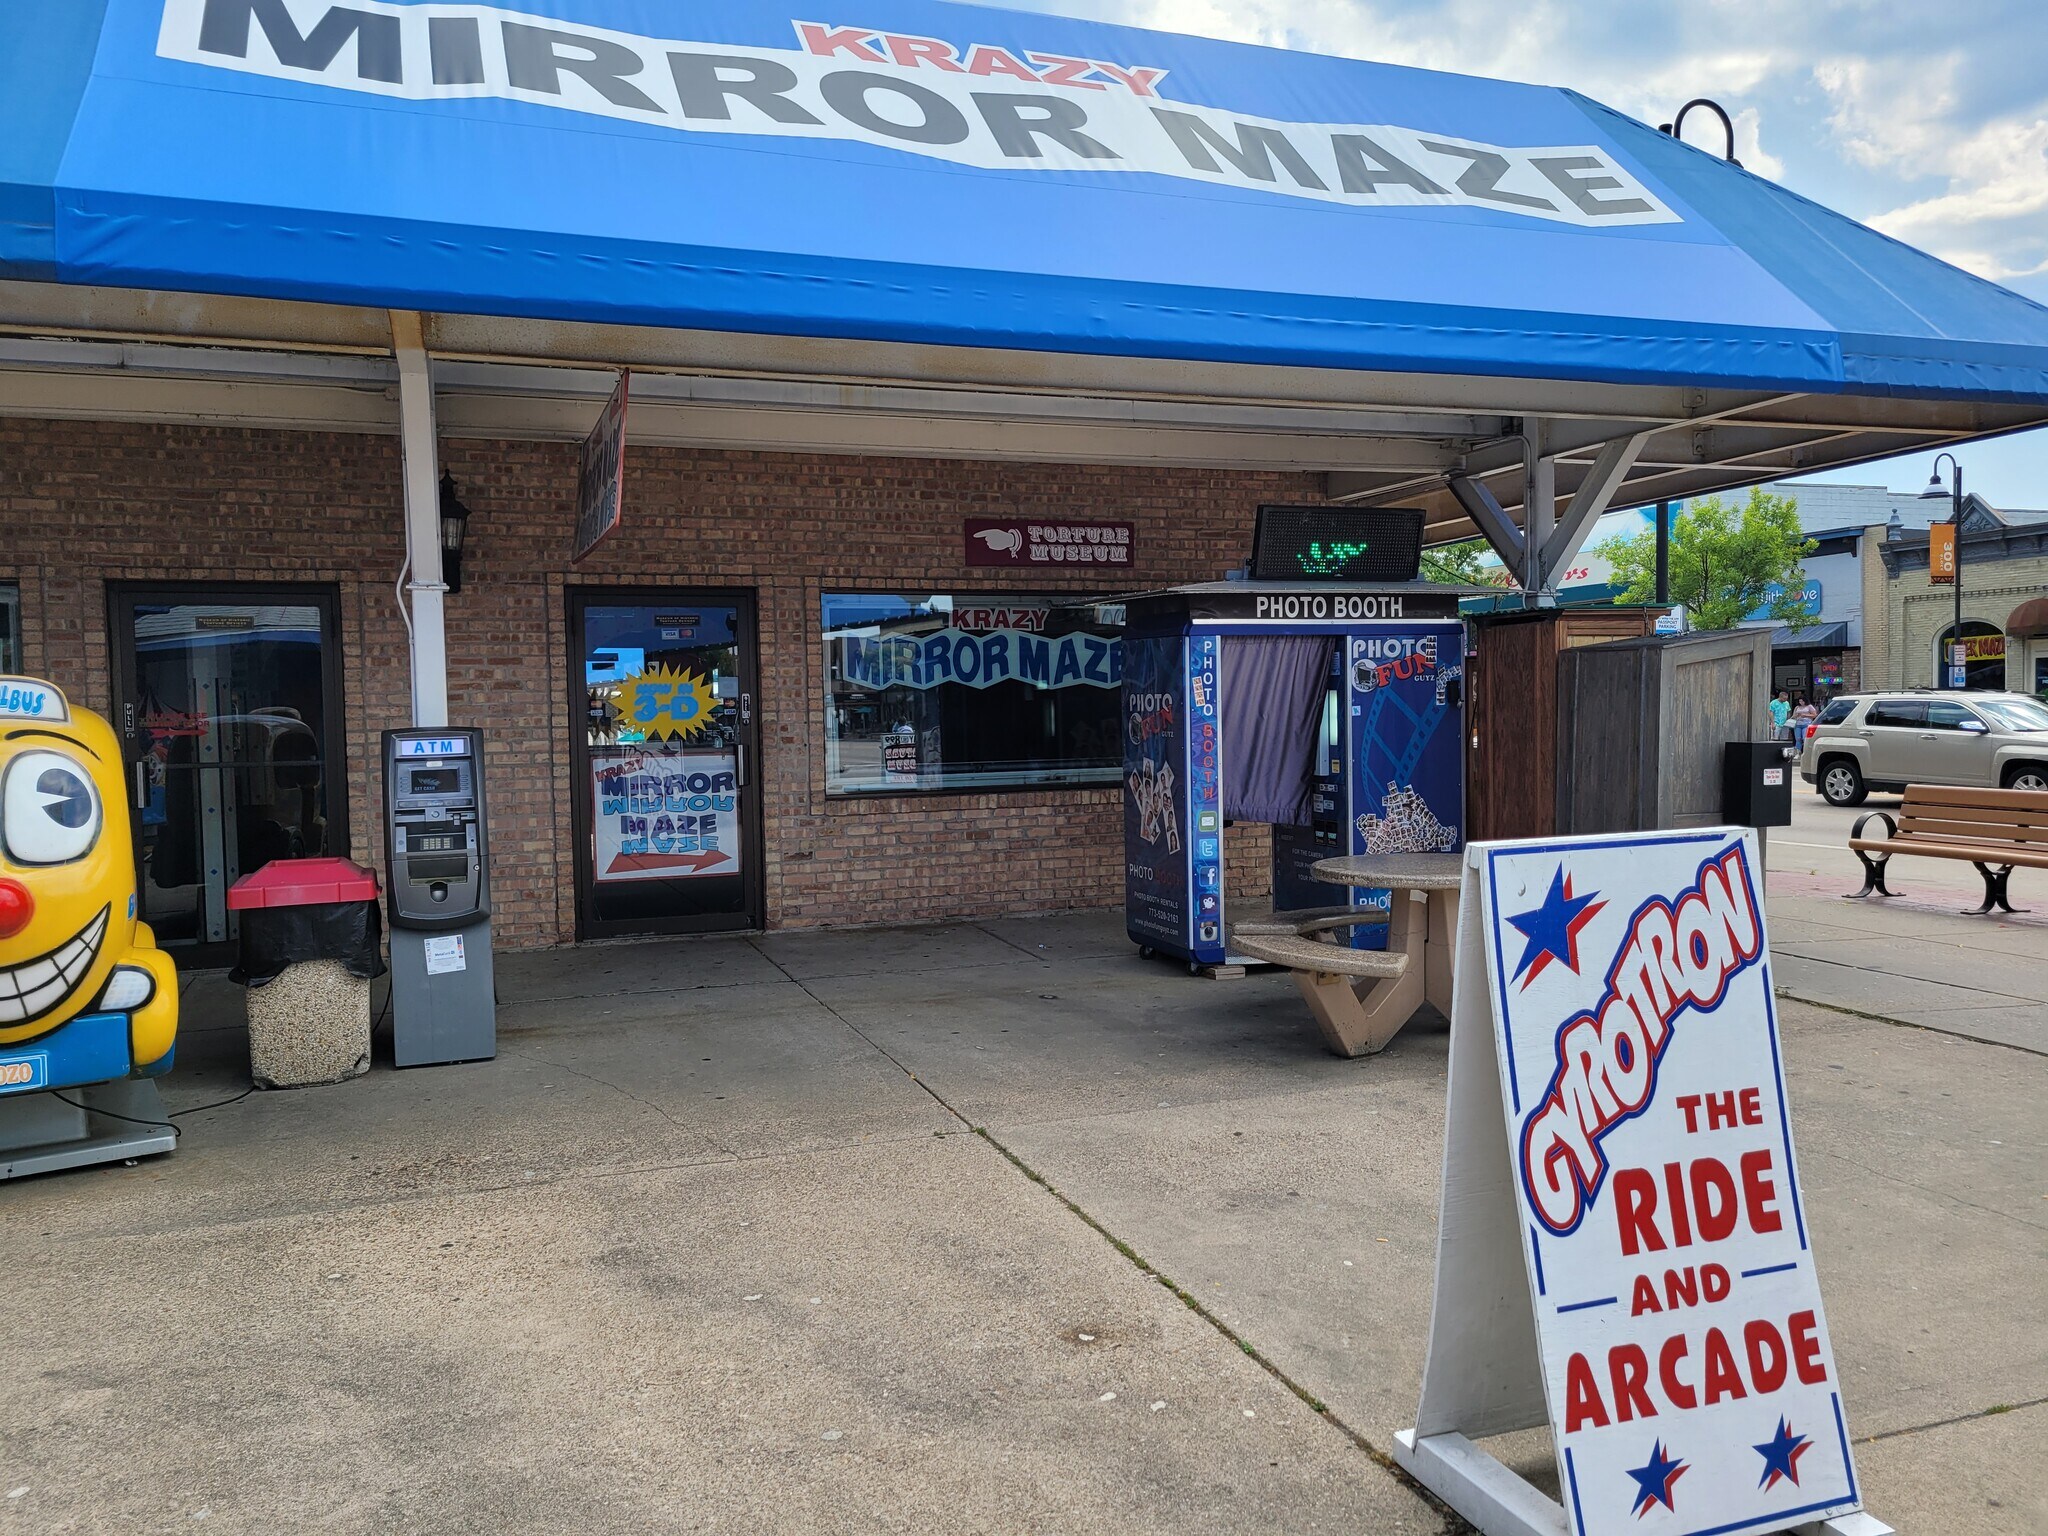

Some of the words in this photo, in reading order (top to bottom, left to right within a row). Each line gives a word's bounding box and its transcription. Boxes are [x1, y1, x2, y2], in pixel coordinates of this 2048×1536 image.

[801, 23, 1164, 96] KRAZY
[197, 0, 1122, 160] MIRROR
[1149, 106, 1656, 217] MAZE
[1027, 525, 1130, 544] TORTURE
[1029, 544, 1128, 562] MUSEUM
[1943, 541, 1953, 572] 300
[952, 608, 1048, 631] KRAZY
[1256, 596, 1327, 618] PHOTO
[1334, 596, 1403, 618] BOOTH
[846, 634, 1010, 687] MIRROR
[1375, 653, 1435, 687] FUN
[1203, 641, 1213, 716] PHOTO
[1414, 674, 1436, 682] GUYZ
[633, 694, 700, 722] 3-D
[1129, 693, 1173, 712] PHOTO
[414, 741, 453, 753] ATM
[1202, 724, 1214, 799] BOOTH
[595, 758, 644, 783] KRAZY
[601, 771, 735, 797] MIRROR
[620, 813, 718, 840] MAZE
[1129, 863, 1154, 881] PHOTO
[1521, 842, 1763, 1234] GYROTRON
[1676, 1087, 1764, 1134] THE
[1612, 1148, 1783, 1257] RIDE
[1630, 1262, 1731, 1317] AND
[1564, 1309, 1828, 1434] ARCADE
